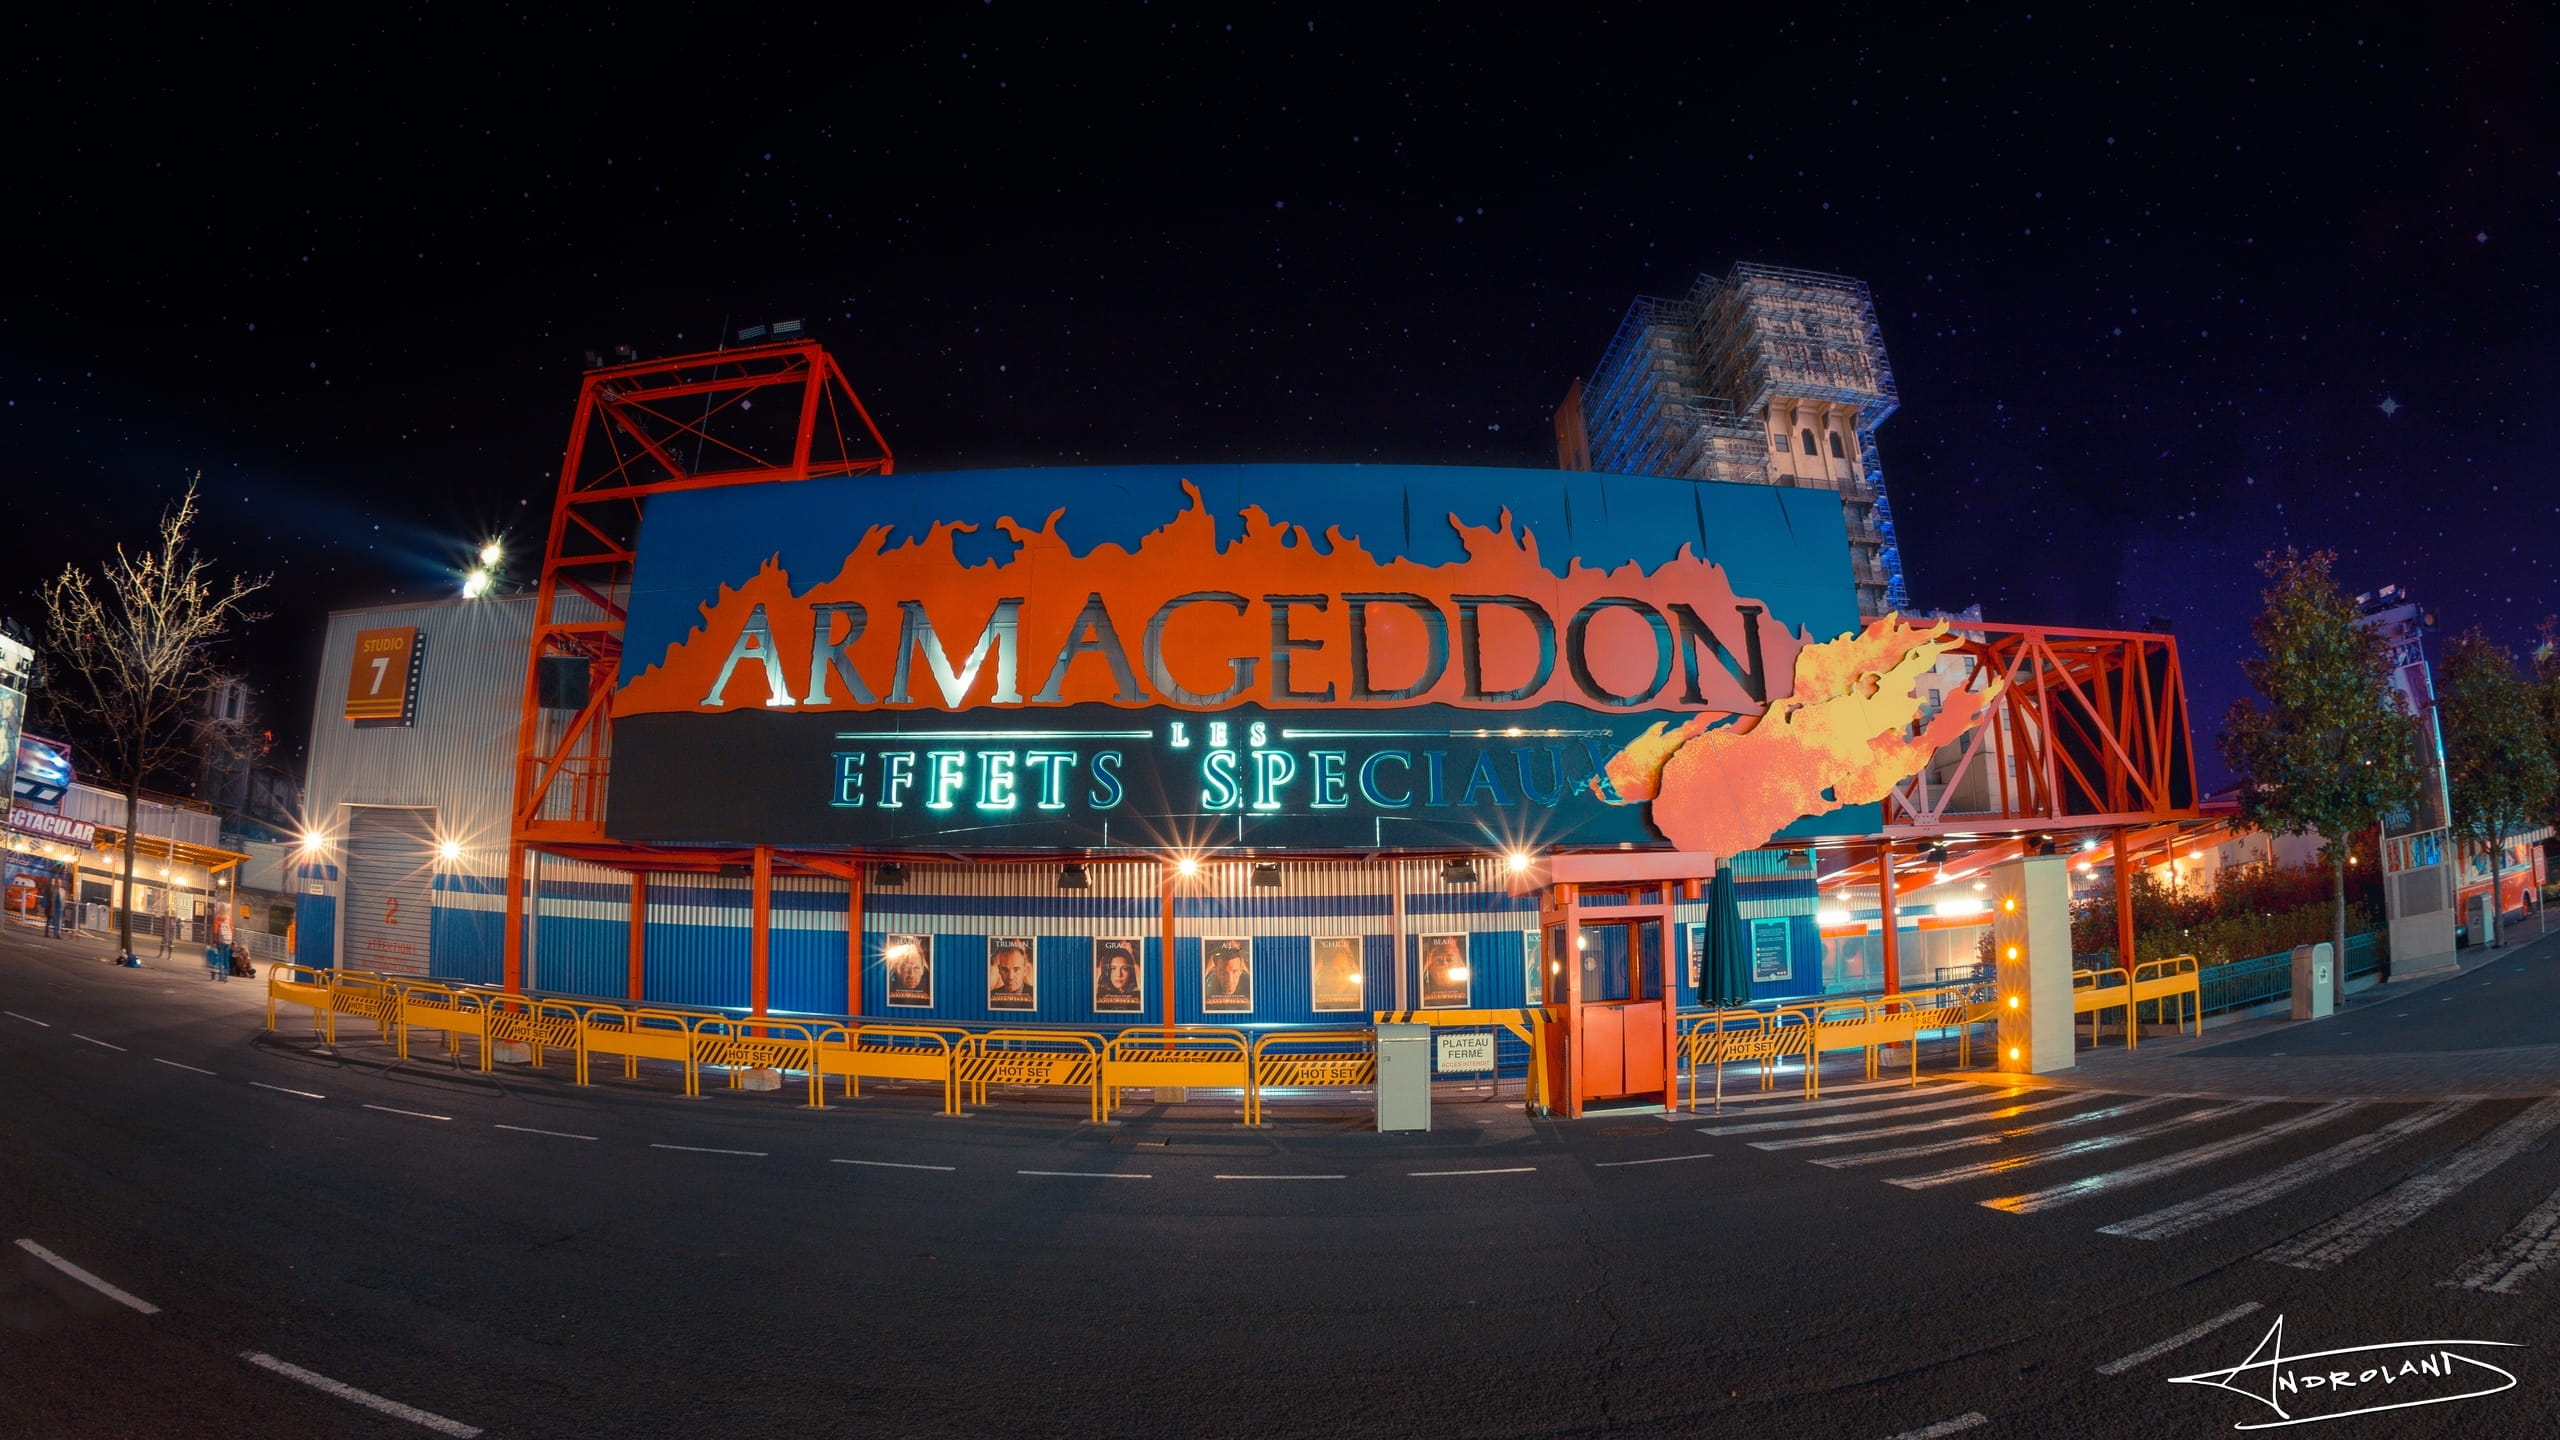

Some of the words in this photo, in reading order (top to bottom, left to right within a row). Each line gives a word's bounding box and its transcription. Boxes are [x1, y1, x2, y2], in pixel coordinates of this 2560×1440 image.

[363, 637, 404, 653] STUDIO
[700, 591, 1768, 708] ARMAGEDDON
[370, 657, 390, 696] 7
[1170, 721, 1267, 748] LES
[829, 751, 1124, 809] EFFETS
[1201, 737, 1626, 810] SPECIAUX
[384, 896, 399, 926] 2
[350, 1002, 363, 1010] HOT
[365, 1003, 377, 1012] SET
[514, 1027, 532, 1035] HOT
[534, 1029, 550, 1038] SET
[1442, 1038, 1489, 1048] PLATEAU
[1730, 1045, 1751, 1054] HOT
[1754, 1042, 1773, 1052] SET
[728, 1050, 750, 1060] HOT
[752, 1050, 773, 1061] SET
[999, 1066, 1024, 1076] HOT
[1027, 1066, 1051, 1077] SET
[1301, 1069, 1327, 1079] HOT
[1331, 1068, 1355, 1078] SET
